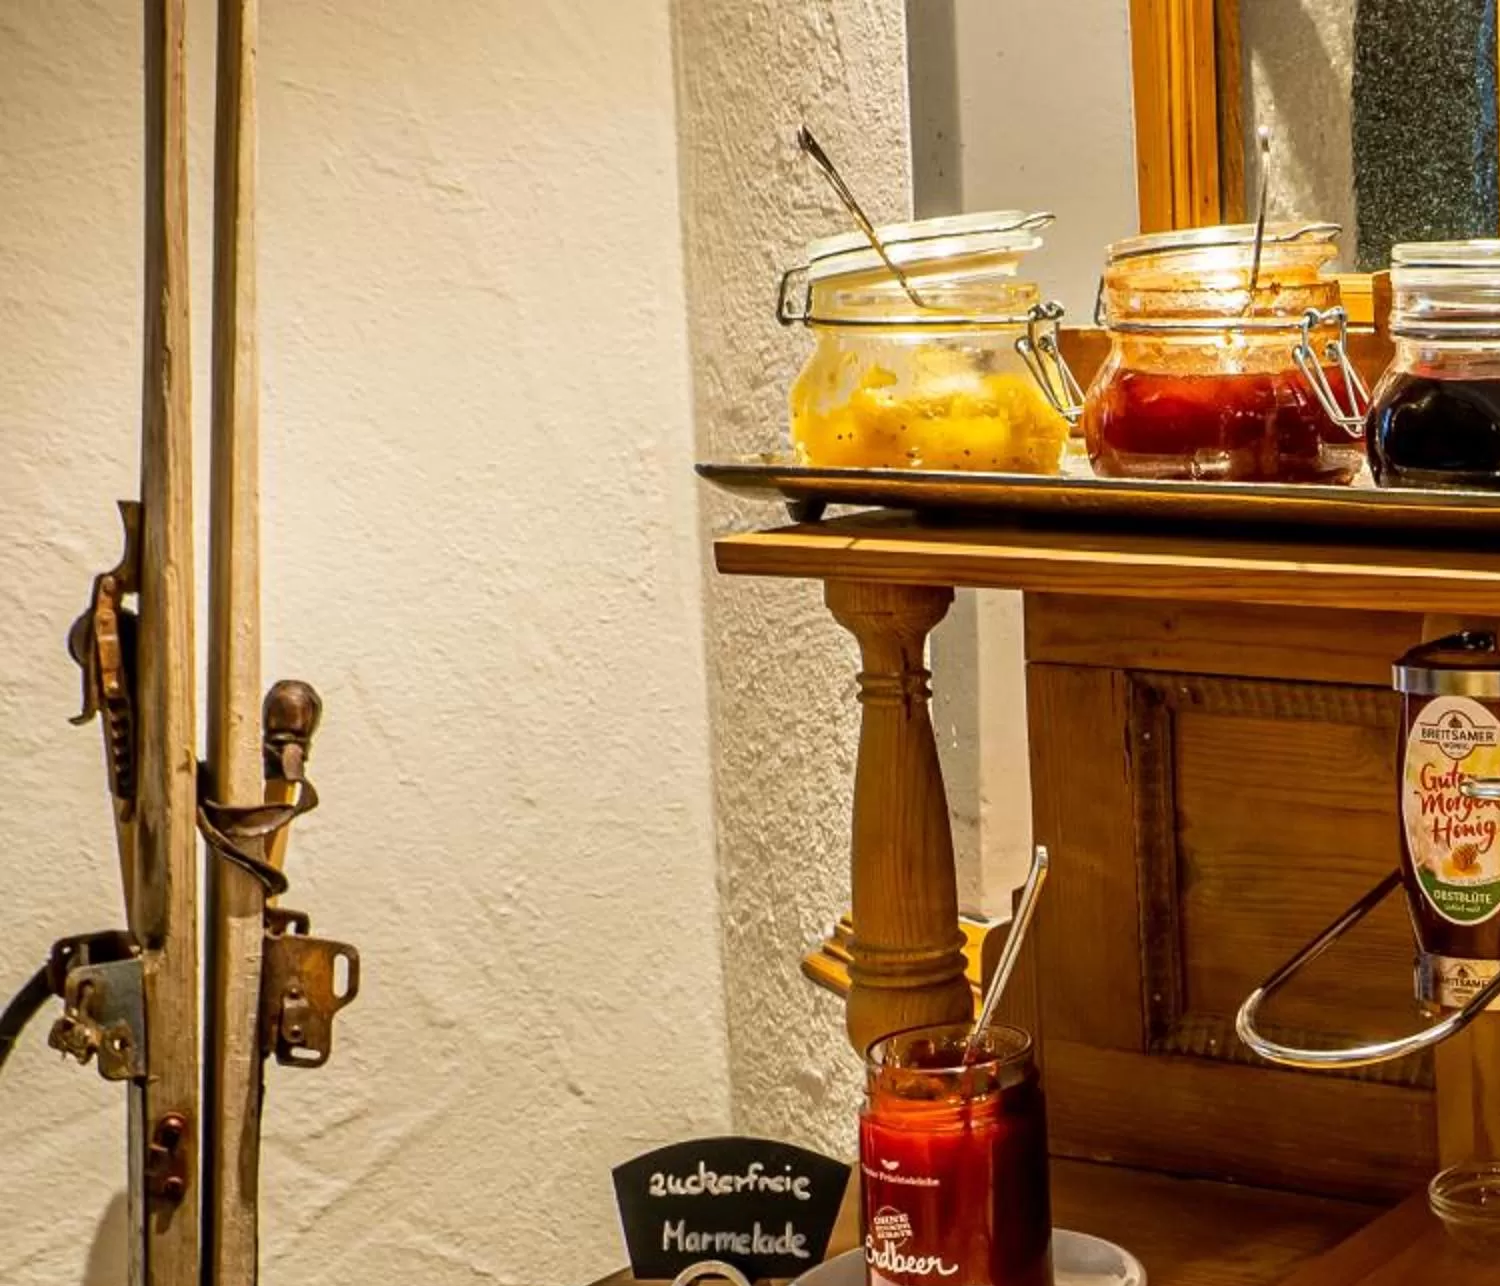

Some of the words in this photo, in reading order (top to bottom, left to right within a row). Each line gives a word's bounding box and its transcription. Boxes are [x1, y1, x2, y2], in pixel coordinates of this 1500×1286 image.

[1421, 728, 1495, 741] BREITSAMER
[1431, 817, 1497, 854] Honig
[650, 1161, 811, 1199] zuckerfreie
[663, 1219, 810, 1257] Marmelade
[865, 1234, 958, 1275] Erdbeer
